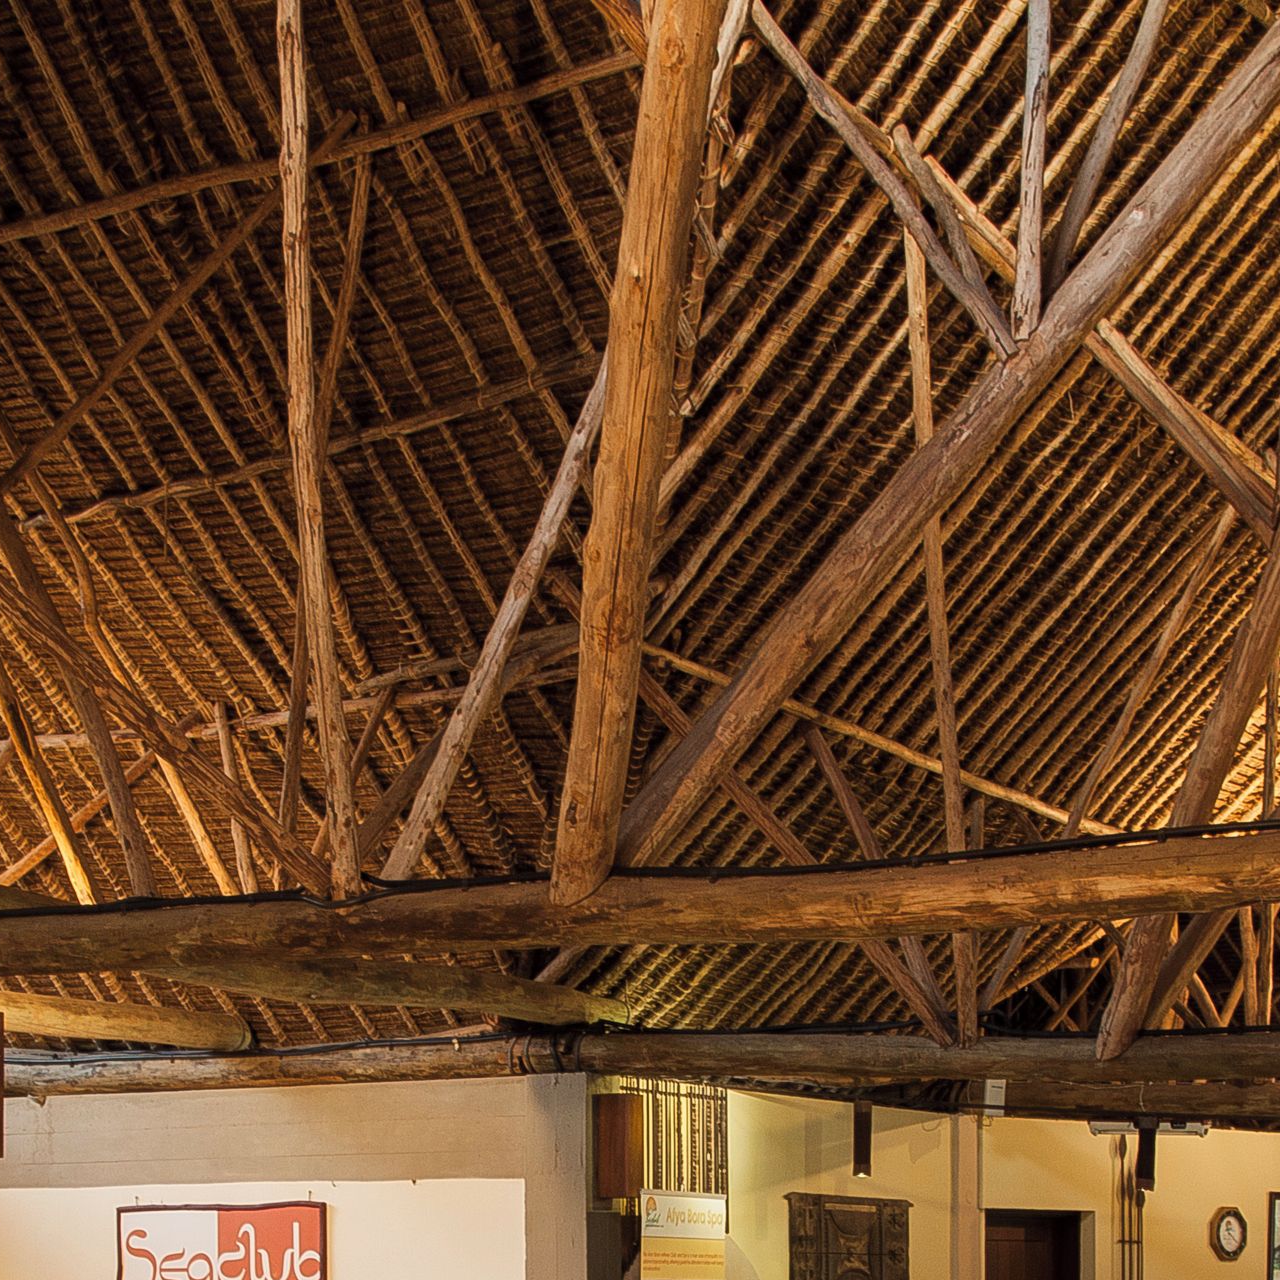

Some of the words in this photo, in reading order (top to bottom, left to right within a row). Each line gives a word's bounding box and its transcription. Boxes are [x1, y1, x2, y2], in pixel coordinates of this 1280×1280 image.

[666, 1207, 686, 1226] Afya
[688, 1208, 706, 1225] Bora
[707, 1210, 723, 1228] Spa
